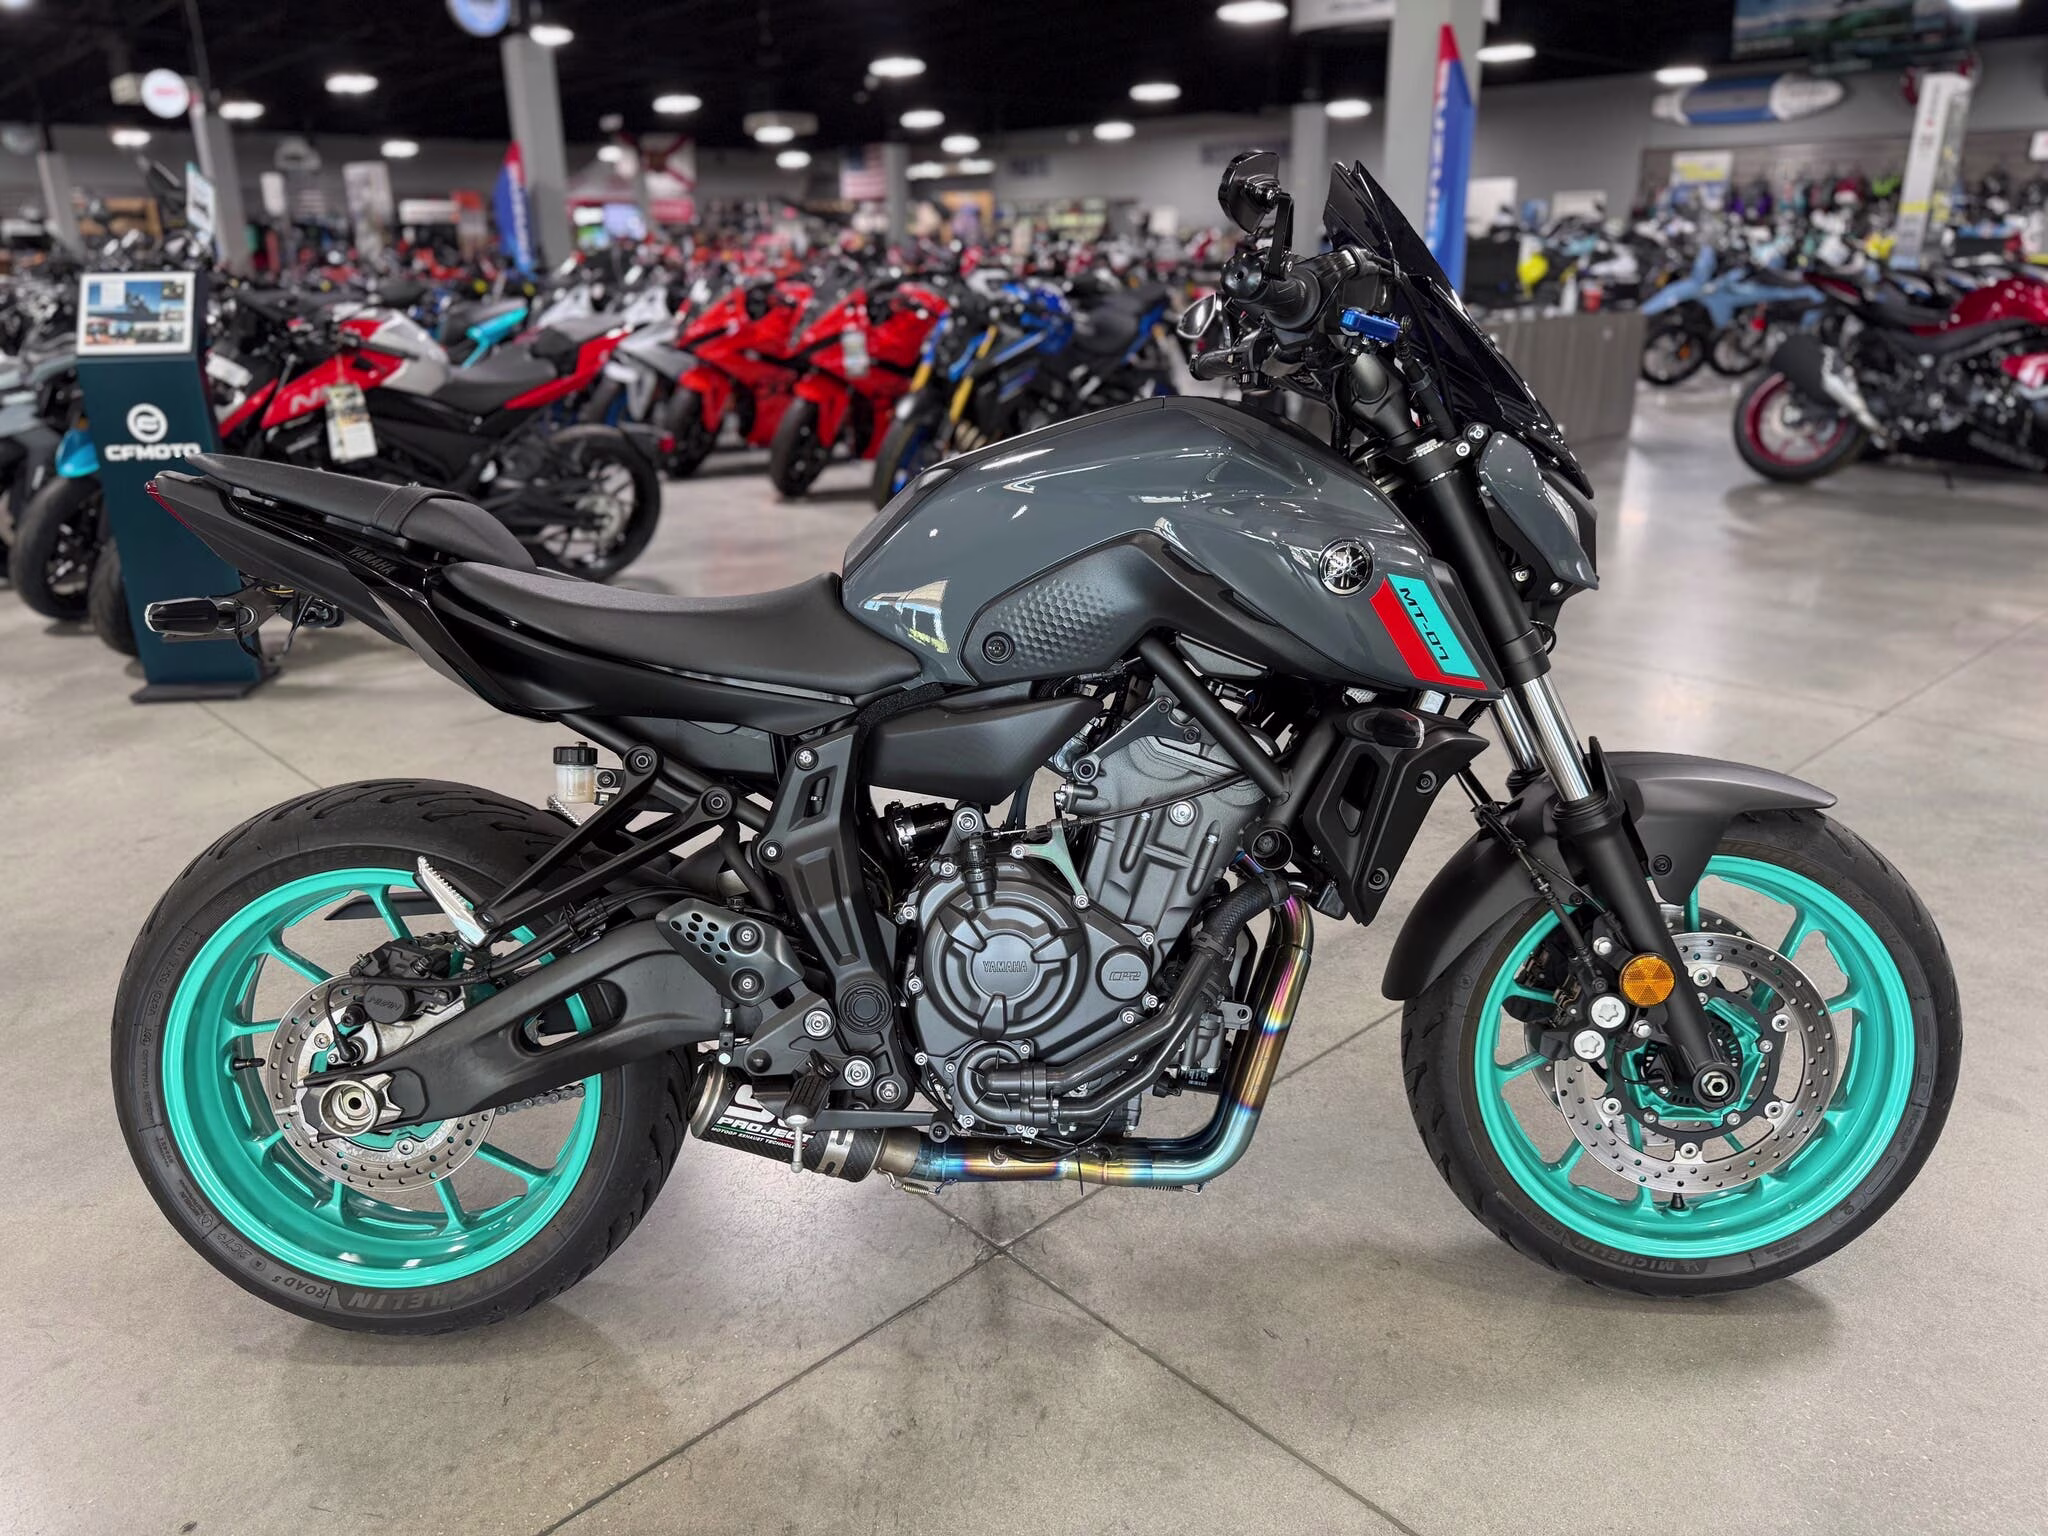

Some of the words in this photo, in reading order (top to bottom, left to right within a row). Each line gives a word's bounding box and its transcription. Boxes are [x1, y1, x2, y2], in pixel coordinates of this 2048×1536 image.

[104, 442, 200, 461] CFMOTO
[347, 546, 399, 575] YAMAHA
[1400, 587, 1449, 660] MT-07
[983, 960, 1027, 973] YAMAHA
[711, 1127, 738, 1136] MOTOGP
[738, 1133, 764, 1142] EXHAUST
[717, 1116, 814, 1143] PROJECT
[284, 1277, 328, 1299] ROAD
